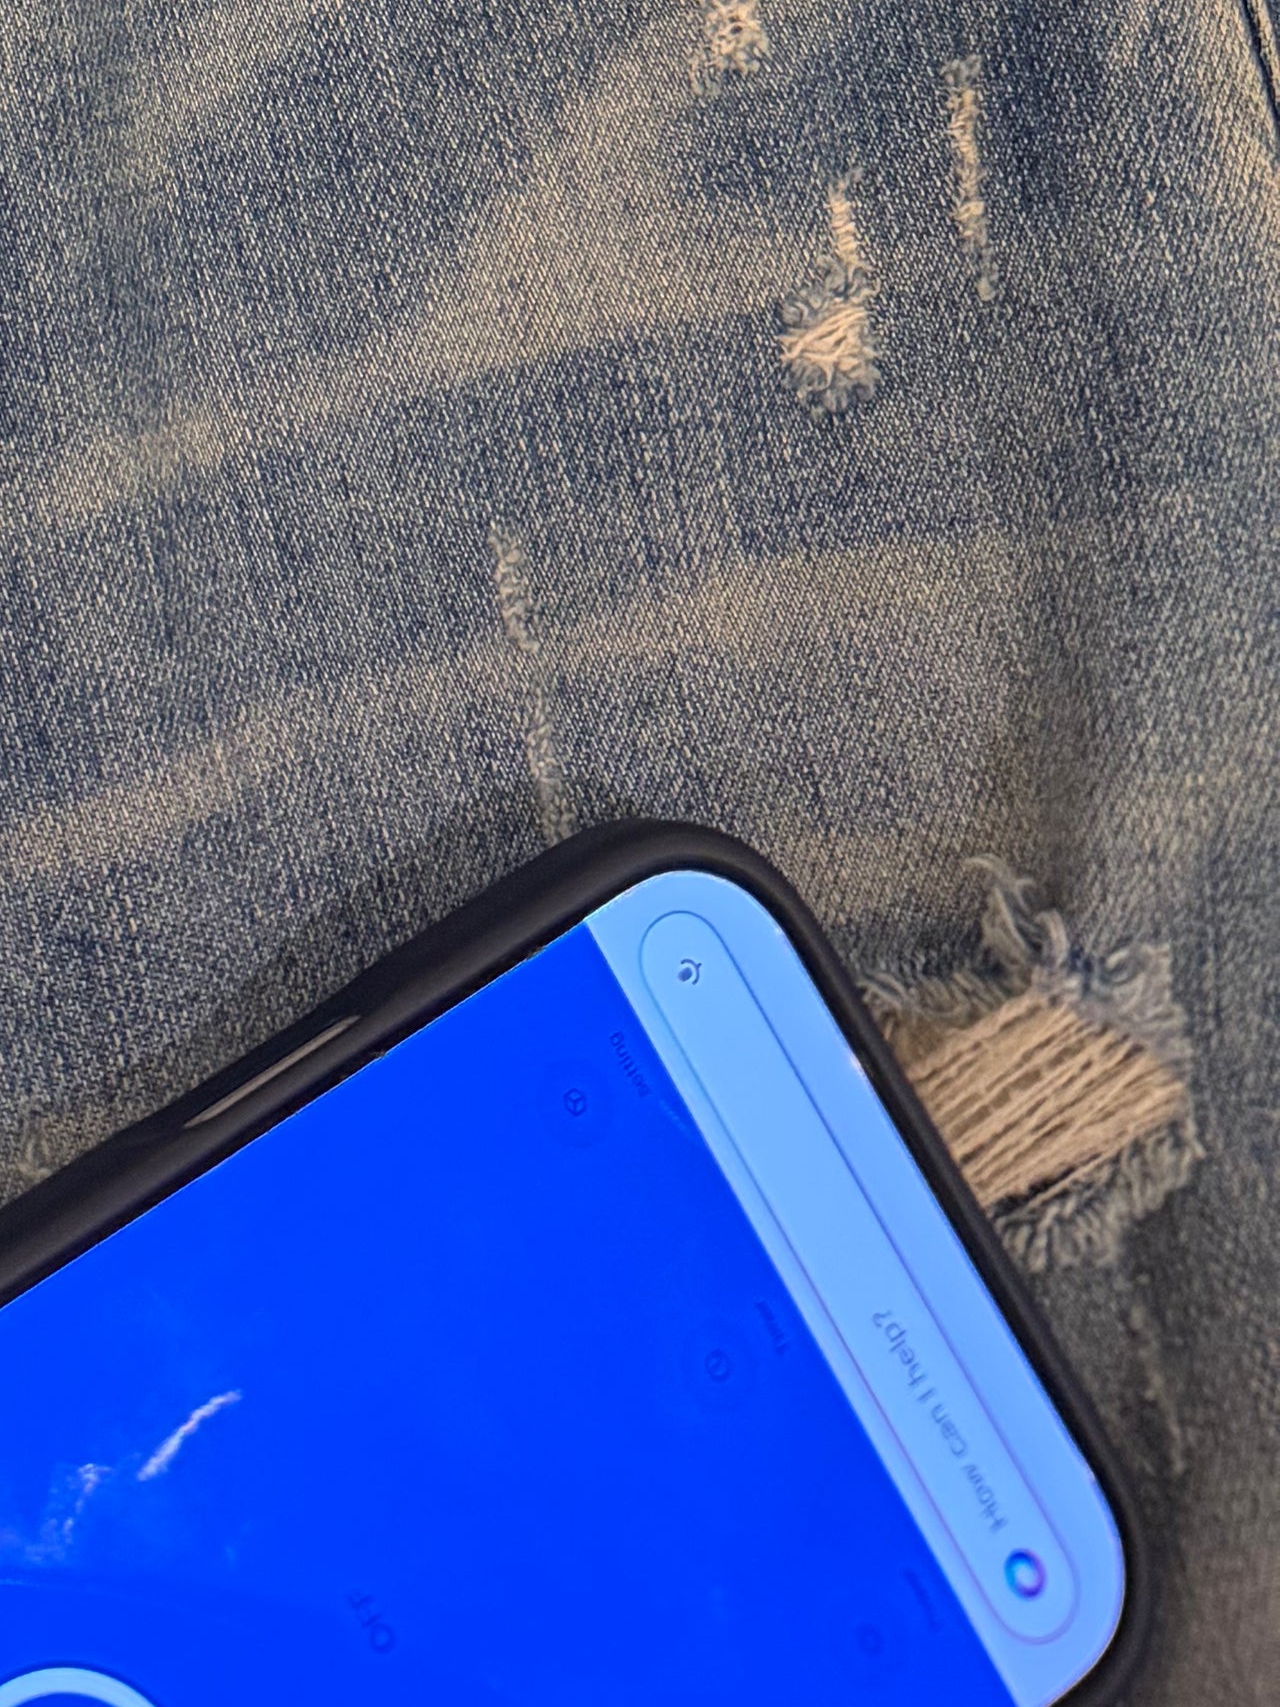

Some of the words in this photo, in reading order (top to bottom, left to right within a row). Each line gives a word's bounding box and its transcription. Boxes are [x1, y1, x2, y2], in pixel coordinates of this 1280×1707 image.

[871, 1309, 930, 1388] help?
[931, 1403, 969, 1460] can
[961, 1462, 1009, 1533] How
